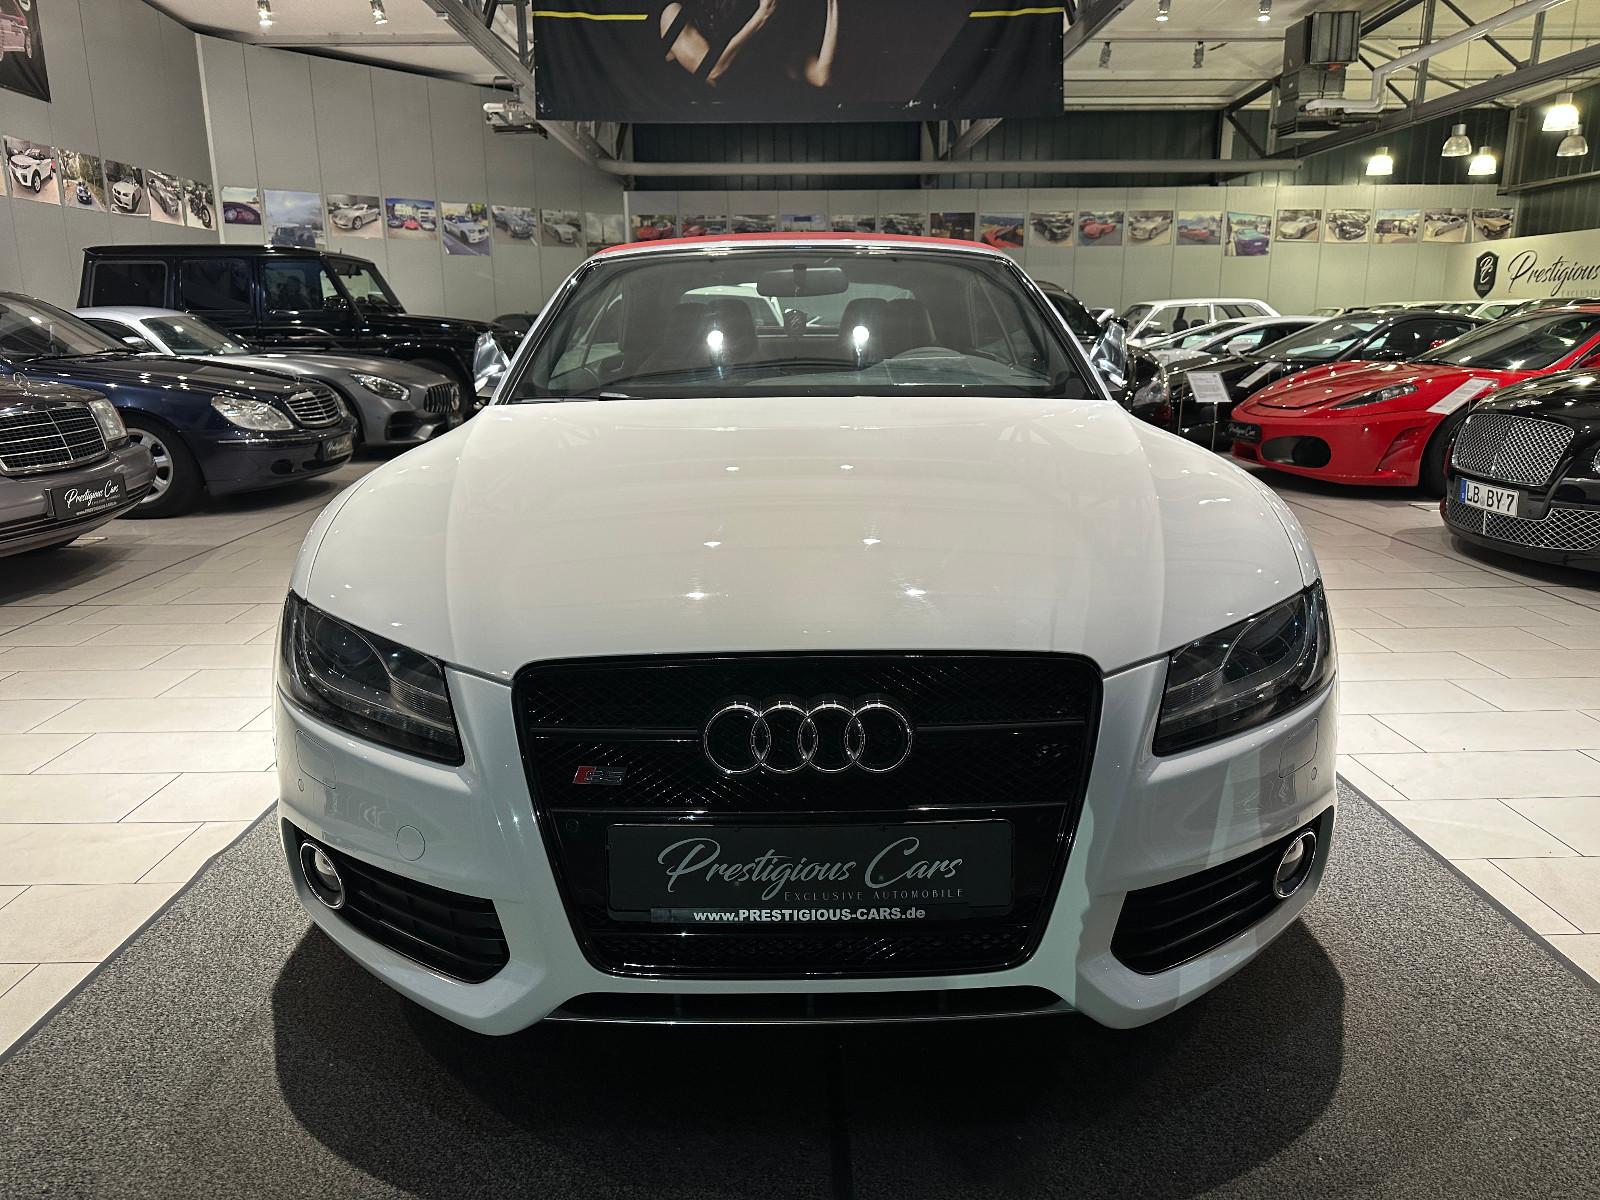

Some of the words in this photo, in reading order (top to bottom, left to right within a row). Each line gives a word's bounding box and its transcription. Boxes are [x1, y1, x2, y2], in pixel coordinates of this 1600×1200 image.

[1508, 249, 1600, 297] Prestigious
[64, 488, 104, 509] Prestigious
[1466, 483, 1480, 503] LB
[1486, 489, 1504, 510] BY
[1506, 493, 1515, 512] 7
[657, 837, 857, 901] Prestigious
[864, 836, 963, 889] Cars
[784, 891, 863, 901] EXCLUSIVE
[873, 888, 964, 900] AUTOMOBILE
[693, 907, 926, 922] www.PRESTIGIOUS-CARS.de
